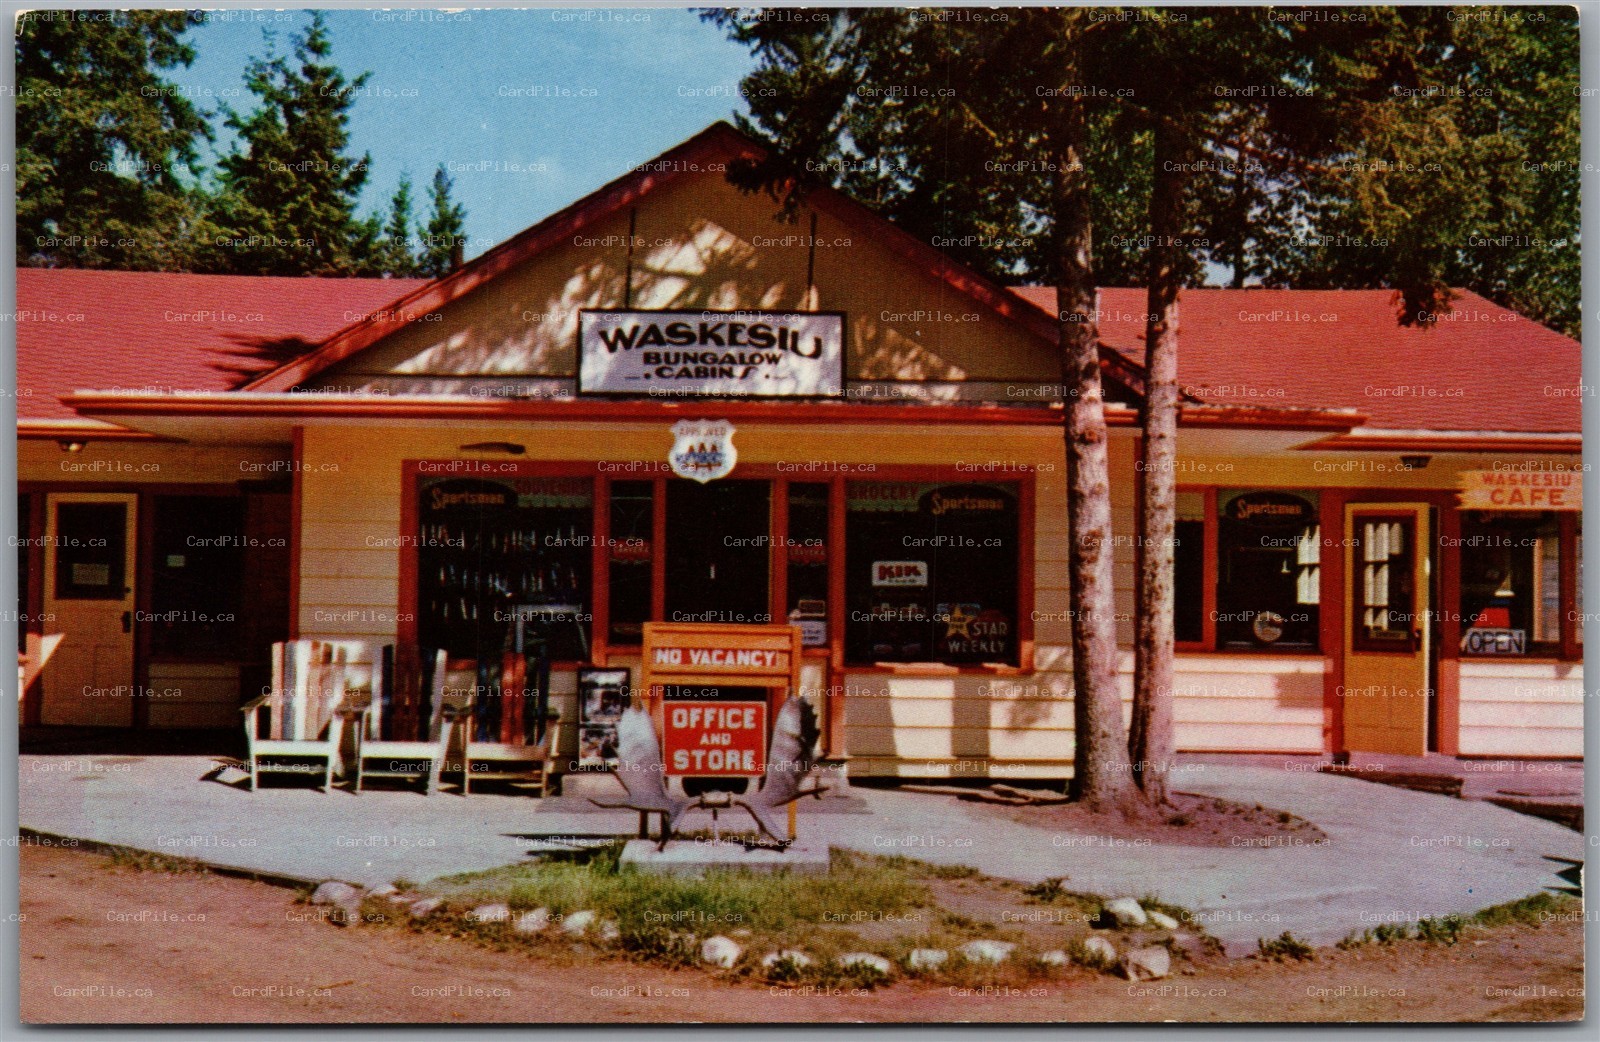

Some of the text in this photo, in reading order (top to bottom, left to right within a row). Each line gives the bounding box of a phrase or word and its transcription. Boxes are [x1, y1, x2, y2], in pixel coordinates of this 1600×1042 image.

[599, 322, 823, 360] WASKESIU
[643, 351, 783, 366] BUNGALOW
[1482, 473, 1573, 487] WASKESIU
[431, 486, 506, 510] Sportsman
[930, 491, 1005, 515] Sportsman
[1489, 488, 1566, 506] CAFE
[1236, 497, 1303, 519] Sportsman
[972, 621, 1008, 636] STAR
[947, 639, 1007, 653] WEEKLY
[1468, 630, 1524, 654] OPEN
[655, 649, 777, 667] NO VACANCY
[672, 708, 757, 730] OFFICE
[700, 733, 732, 746] AND
[672, 749, 757, 771] STORE
